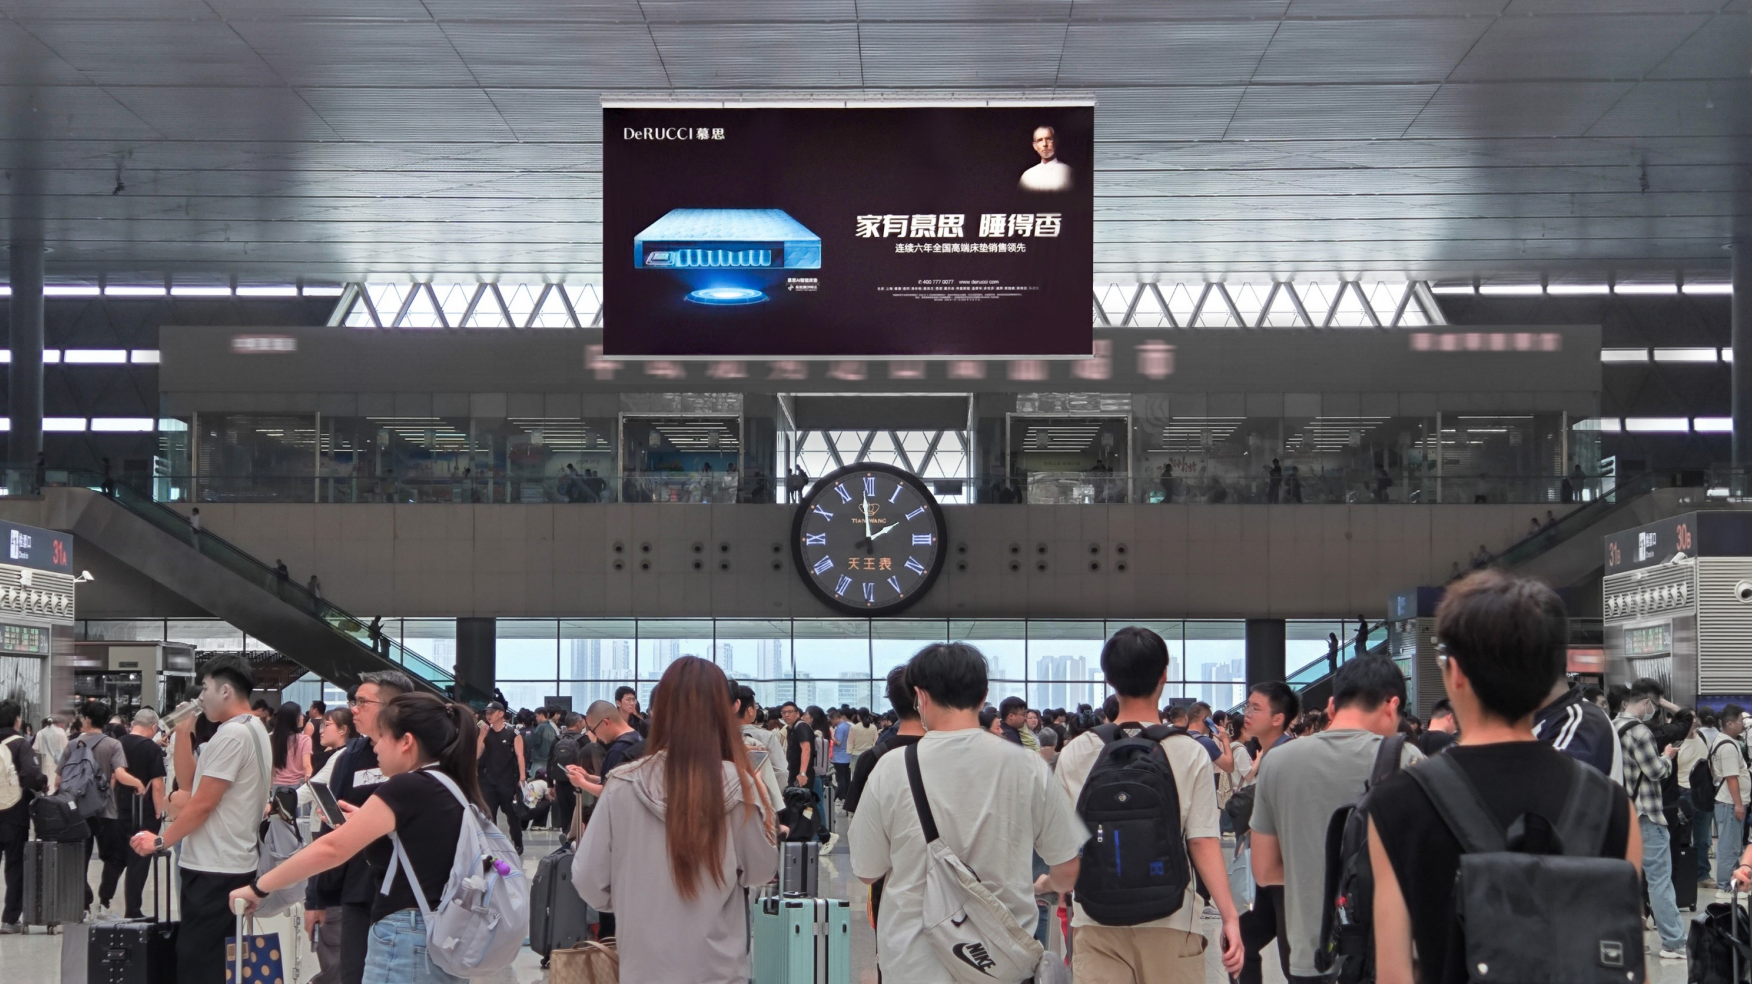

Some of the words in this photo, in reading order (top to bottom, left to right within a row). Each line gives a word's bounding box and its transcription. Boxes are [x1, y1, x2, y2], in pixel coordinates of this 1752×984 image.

[624, 127, 693, 140] DeRUCCI
[696, 127, 725, 140] 慕思
[855, 213, 965, 238] 家有慕思
[978, 212, 1062, 238] 睡得香
[895, 243, 1026, 254] 连续六年全国高端床垫销售领先
[848, 557, 892, 570] 天王表
[966, 942, 996, 972] NIKE
